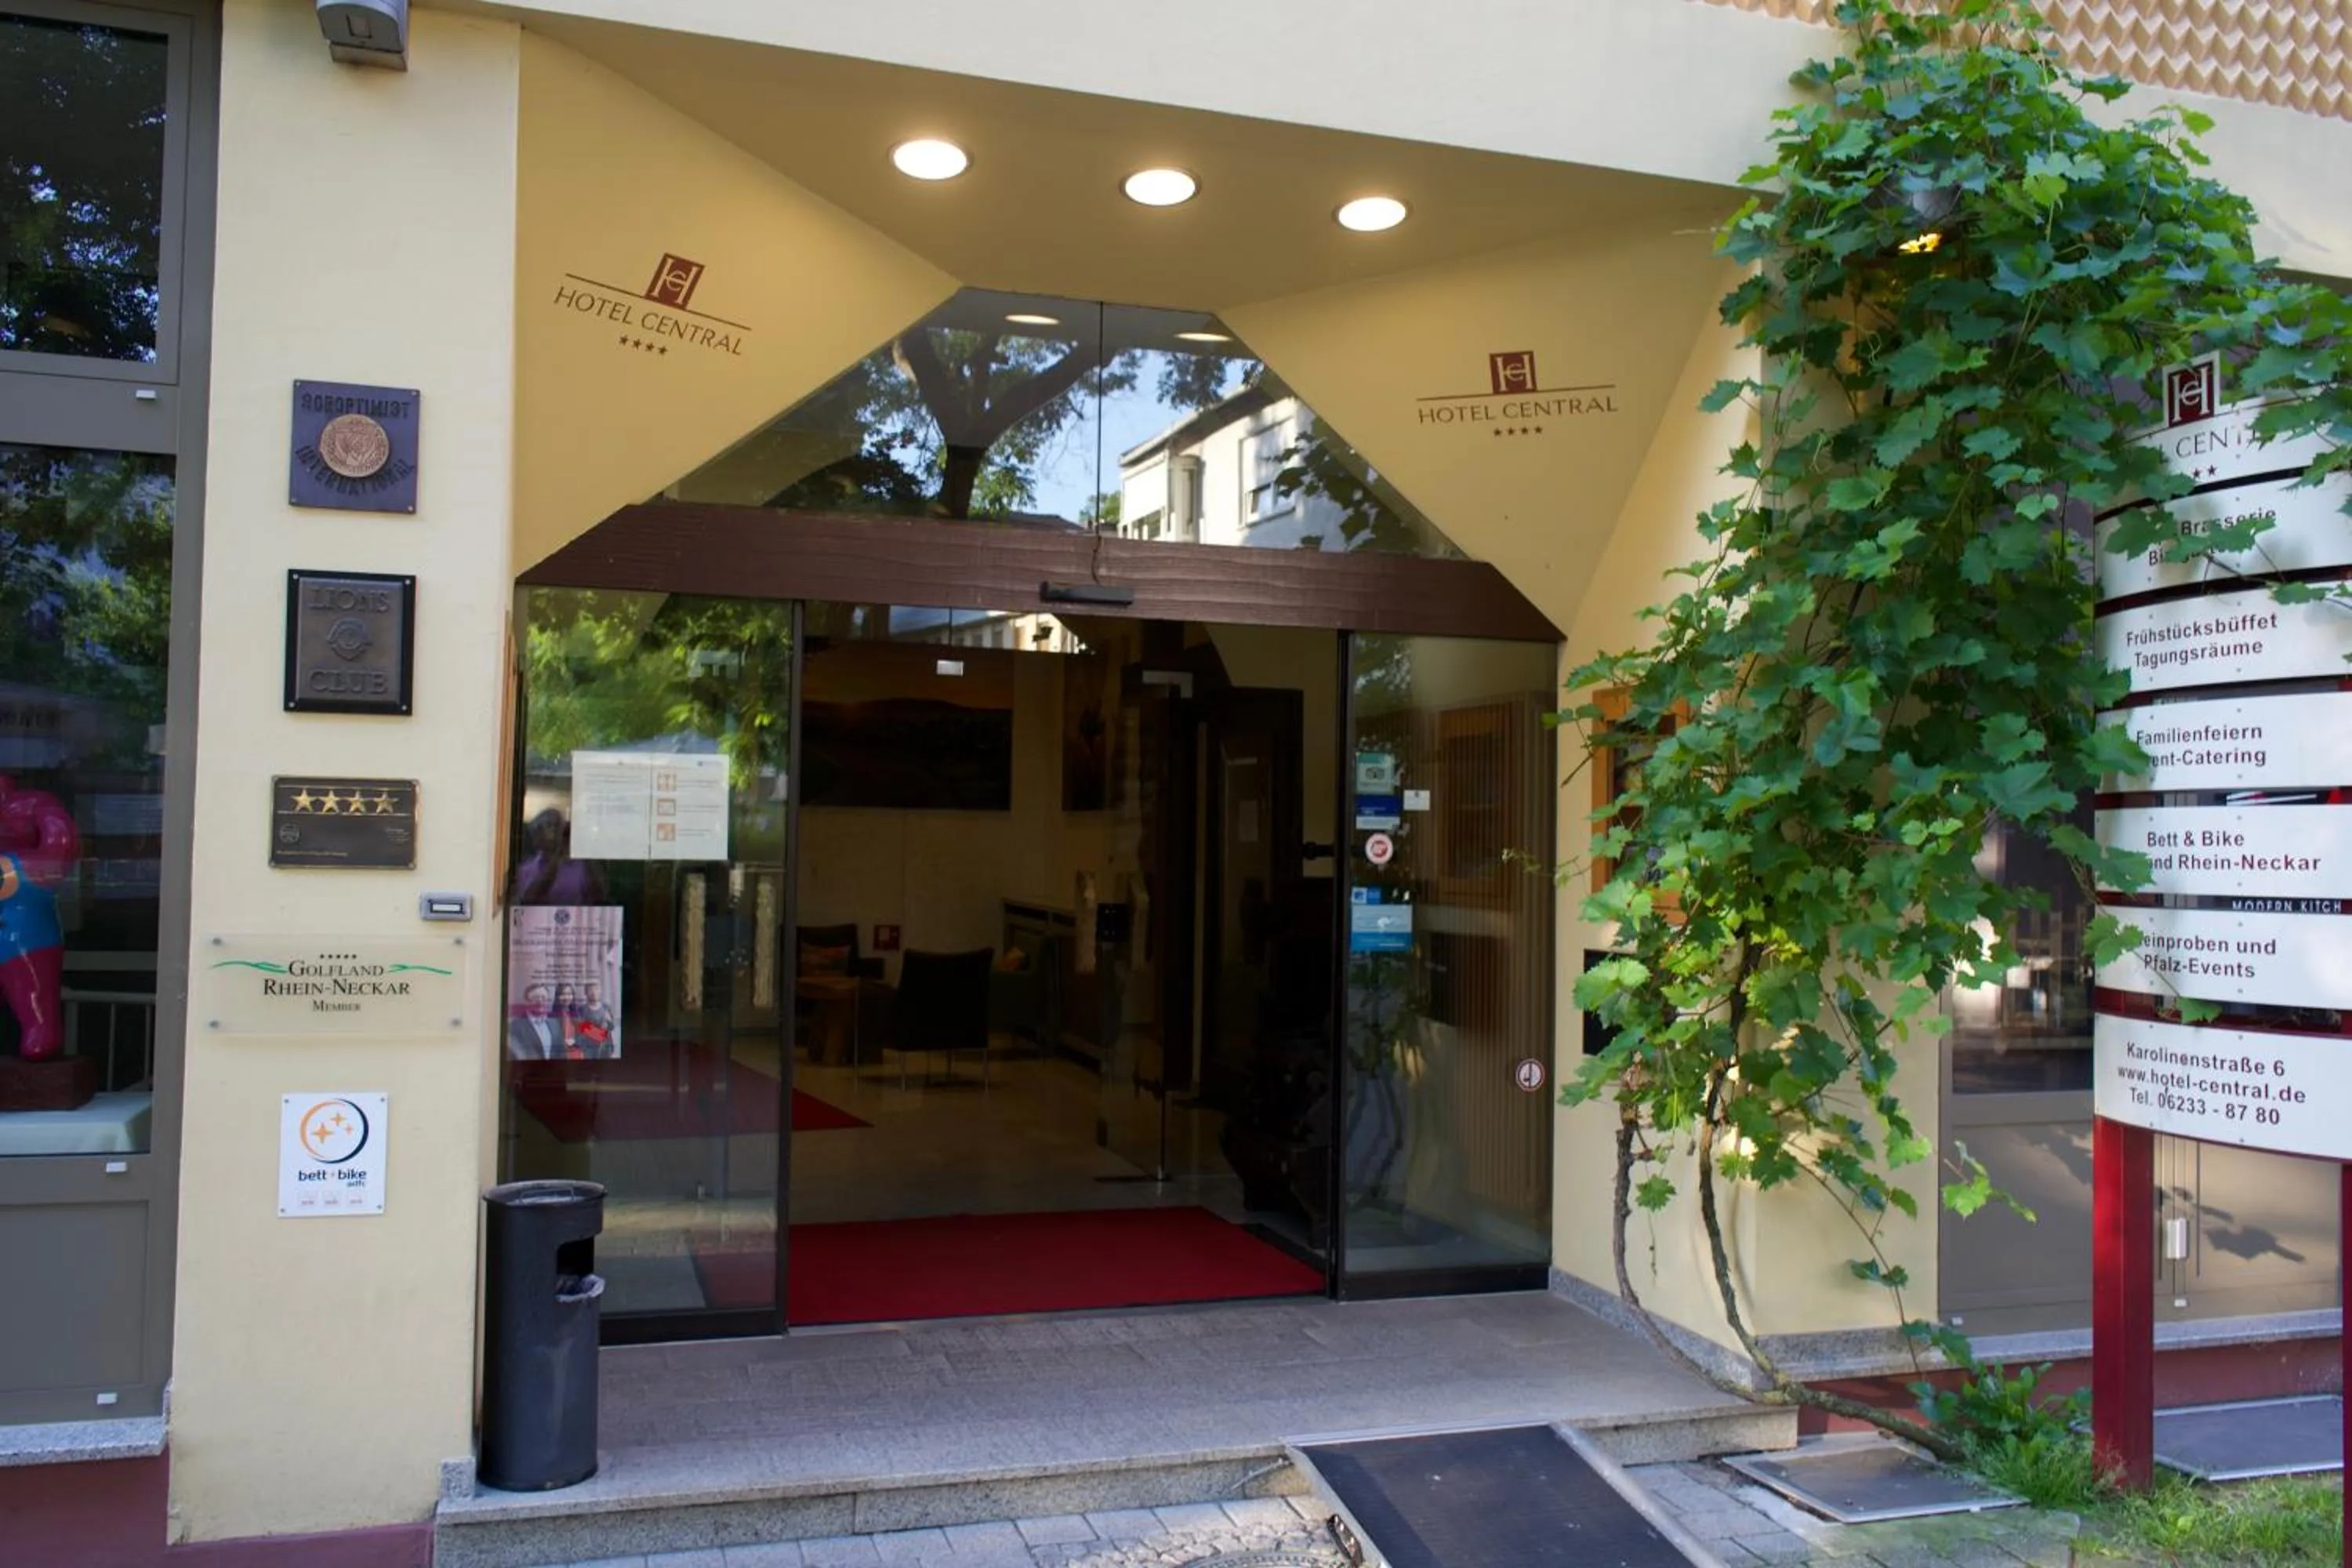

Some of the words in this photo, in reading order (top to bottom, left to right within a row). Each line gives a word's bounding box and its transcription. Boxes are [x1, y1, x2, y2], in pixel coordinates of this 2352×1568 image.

[553, 286, 633, 325] HOTEL
[641, 312, 742, 355] CENTRAL
[1418, 405, 1497, 424] HOTEL
[1503, 397, 1619, 419] CENTRAL
[309, 586, 390, 612] LIONS
[2126, 613, 2278, 647] Frühstücksbüffet
[2134, 641, 2264, 669] Tagungsräume
[310, 669, 389, 695] CLUB
[2136, 724, 2263, 745] Familienfeiern
[2151, 748, 2267, 767] ent-Catering
[2147, 831, 2178, 848] Bett
[2183, 831, 2195, 846] &
[2201, 831, 2245, 847] Bike
[2179, 854, 2321, 870] Rhein-Neckar
[2301, 900, 2342, 913] KITCH
[2143, 934, 2229, 953] einproben
[2237, 939, 2277, 955] und
[2144, 954, 2255, 978] Pfalz-Events
[2126, 1041, 2266, 1075] Karolinenstraße
[2273, 1060, 2285, 1077] 6
[2118, 1065, 2307, 1104] www.hotel-central.de
[2130, 1087, 2153, 1106] Tel.
[2158, 1092, 2206, 1116] 06233
[2225, 1103, 2248, 1121] 87
[2256, 1107, 2281, 1126] 80
[338, 1168, 367, 1180] bike
